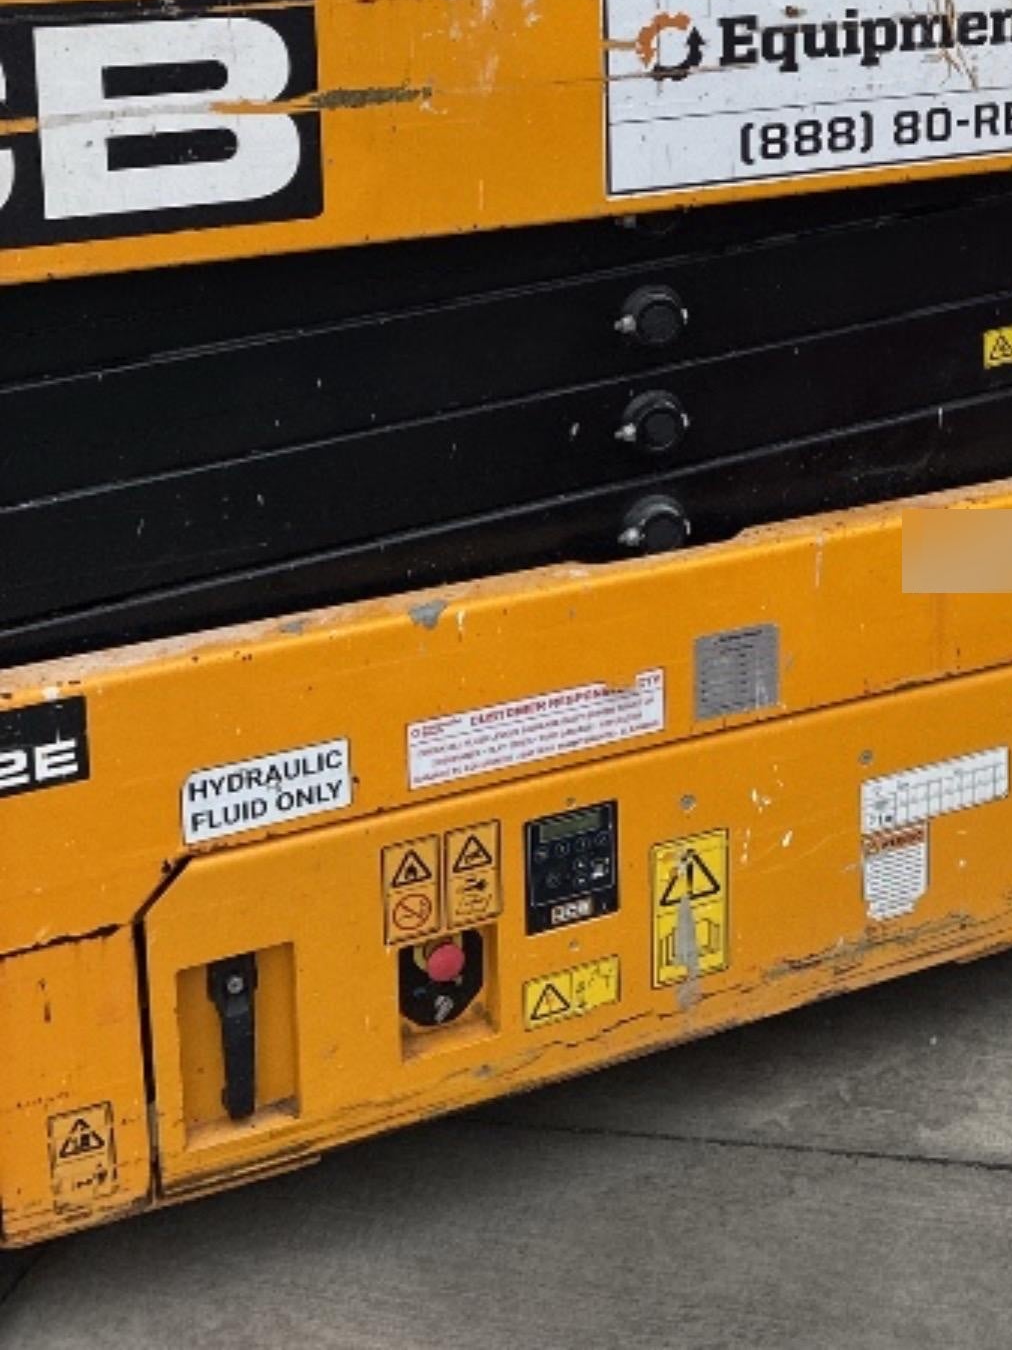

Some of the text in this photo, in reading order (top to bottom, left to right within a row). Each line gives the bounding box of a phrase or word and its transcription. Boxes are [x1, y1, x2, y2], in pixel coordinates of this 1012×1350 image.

[740, 110, 874, 166] (888)
[188, 749, 343, 802] HYDRAULIC
[191, 779, 343, 833] FLUID ONLY
